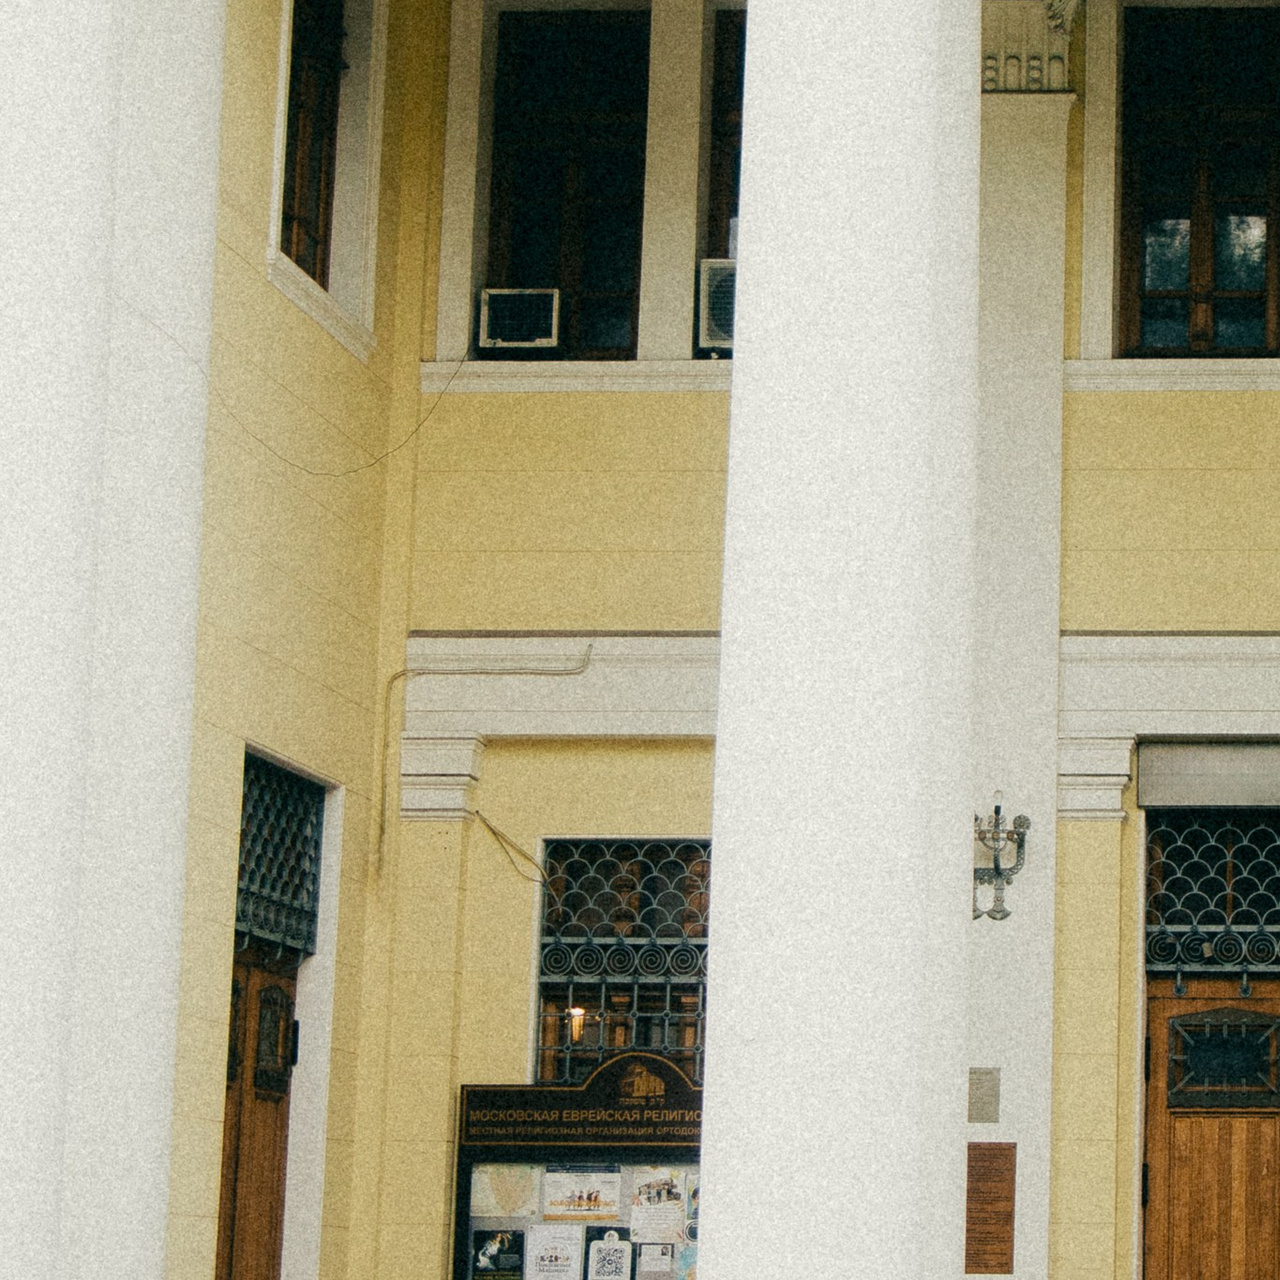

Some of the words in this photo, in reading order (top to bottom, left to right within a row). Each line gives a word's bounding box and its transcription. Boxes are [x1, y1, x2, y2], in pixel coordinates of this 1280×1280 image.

[469, 1109, 559, 1122] МОСКОВСКАЯ
[562, 1107, 640, 1122] ЕВРЕЙСКАЯ
[469, 1126, 514, 1135] МЕСТНАЯ
[515, 1126, 583, 1135] РЕЛИГИОЗНАЯ
[585, 1126, 653, 1136] ОРГАНИЗАЦИЯ
